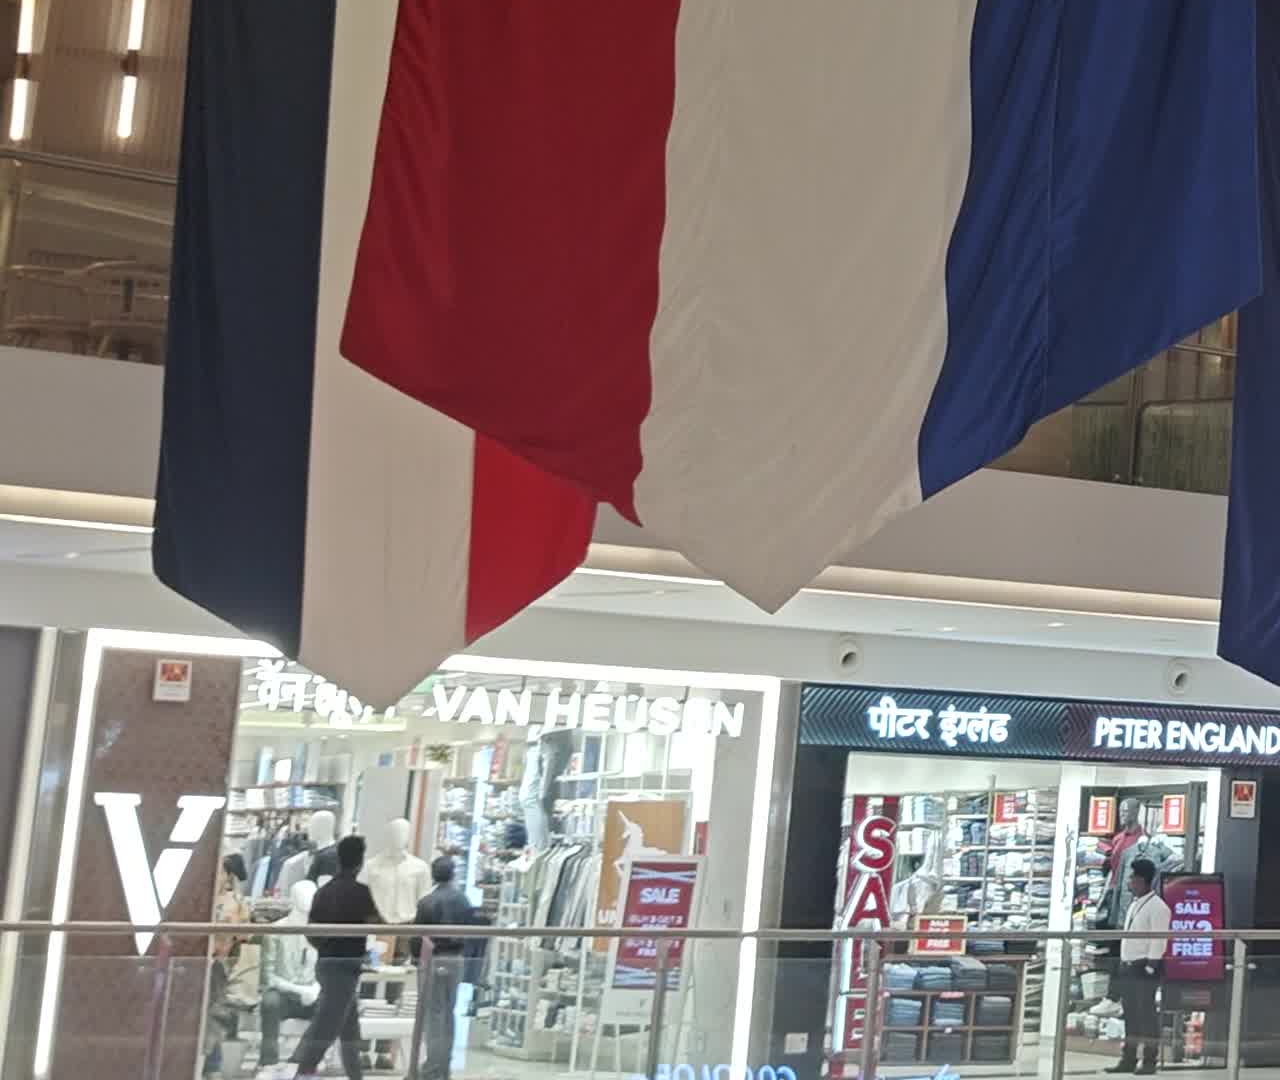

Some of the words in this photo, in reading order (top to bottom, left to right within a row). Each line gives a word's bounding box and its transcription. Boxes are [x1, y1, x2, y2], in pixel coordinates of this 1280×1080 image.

[432, 684, 532, 727] VAN
[546, 689, 745, 738] HEUSEN
[867, 695, 933, 740] पीटर
[1094, 716, 1163, 749] PETER
[639, 887, 681, 905] SALE
[1174, 902, 1211, 915] SALE
[1172, 943, 1213, 956] FREE
